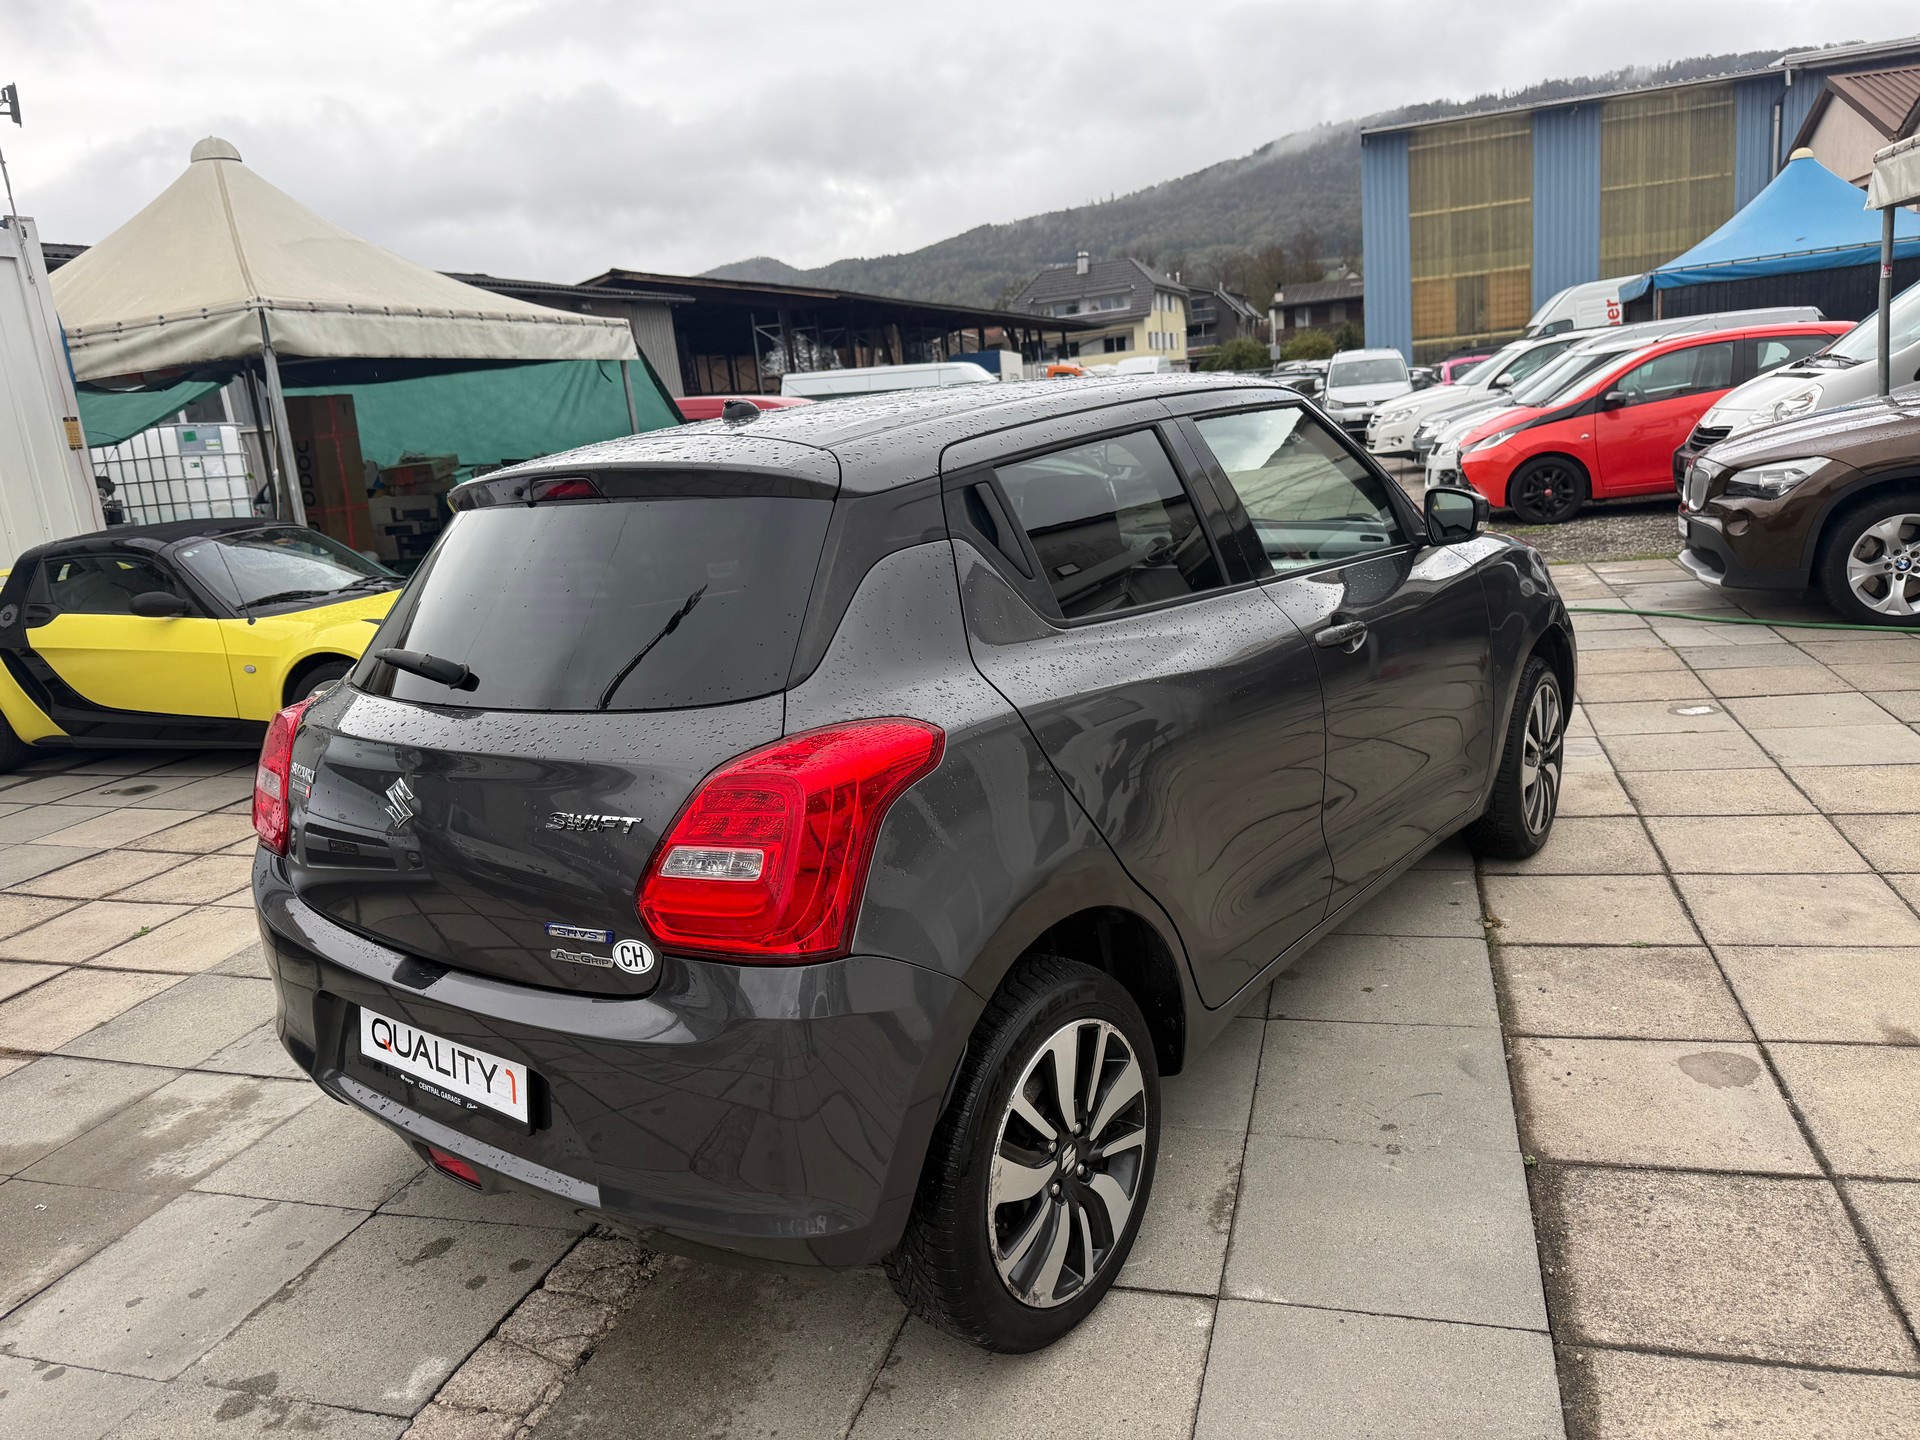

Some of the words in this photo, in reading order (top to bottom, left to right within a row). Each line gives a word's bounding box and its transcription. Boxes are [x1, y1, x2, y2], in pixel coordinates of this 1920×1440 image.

[546, 811, 643, 834] SWIFT
[556, 927, 598, 940] SHVS
[620, 945, 646, 968] CH
[419, 1082, 440, 1097] CENTRAL
[440, 1091, 462, 1105] GARAGE
